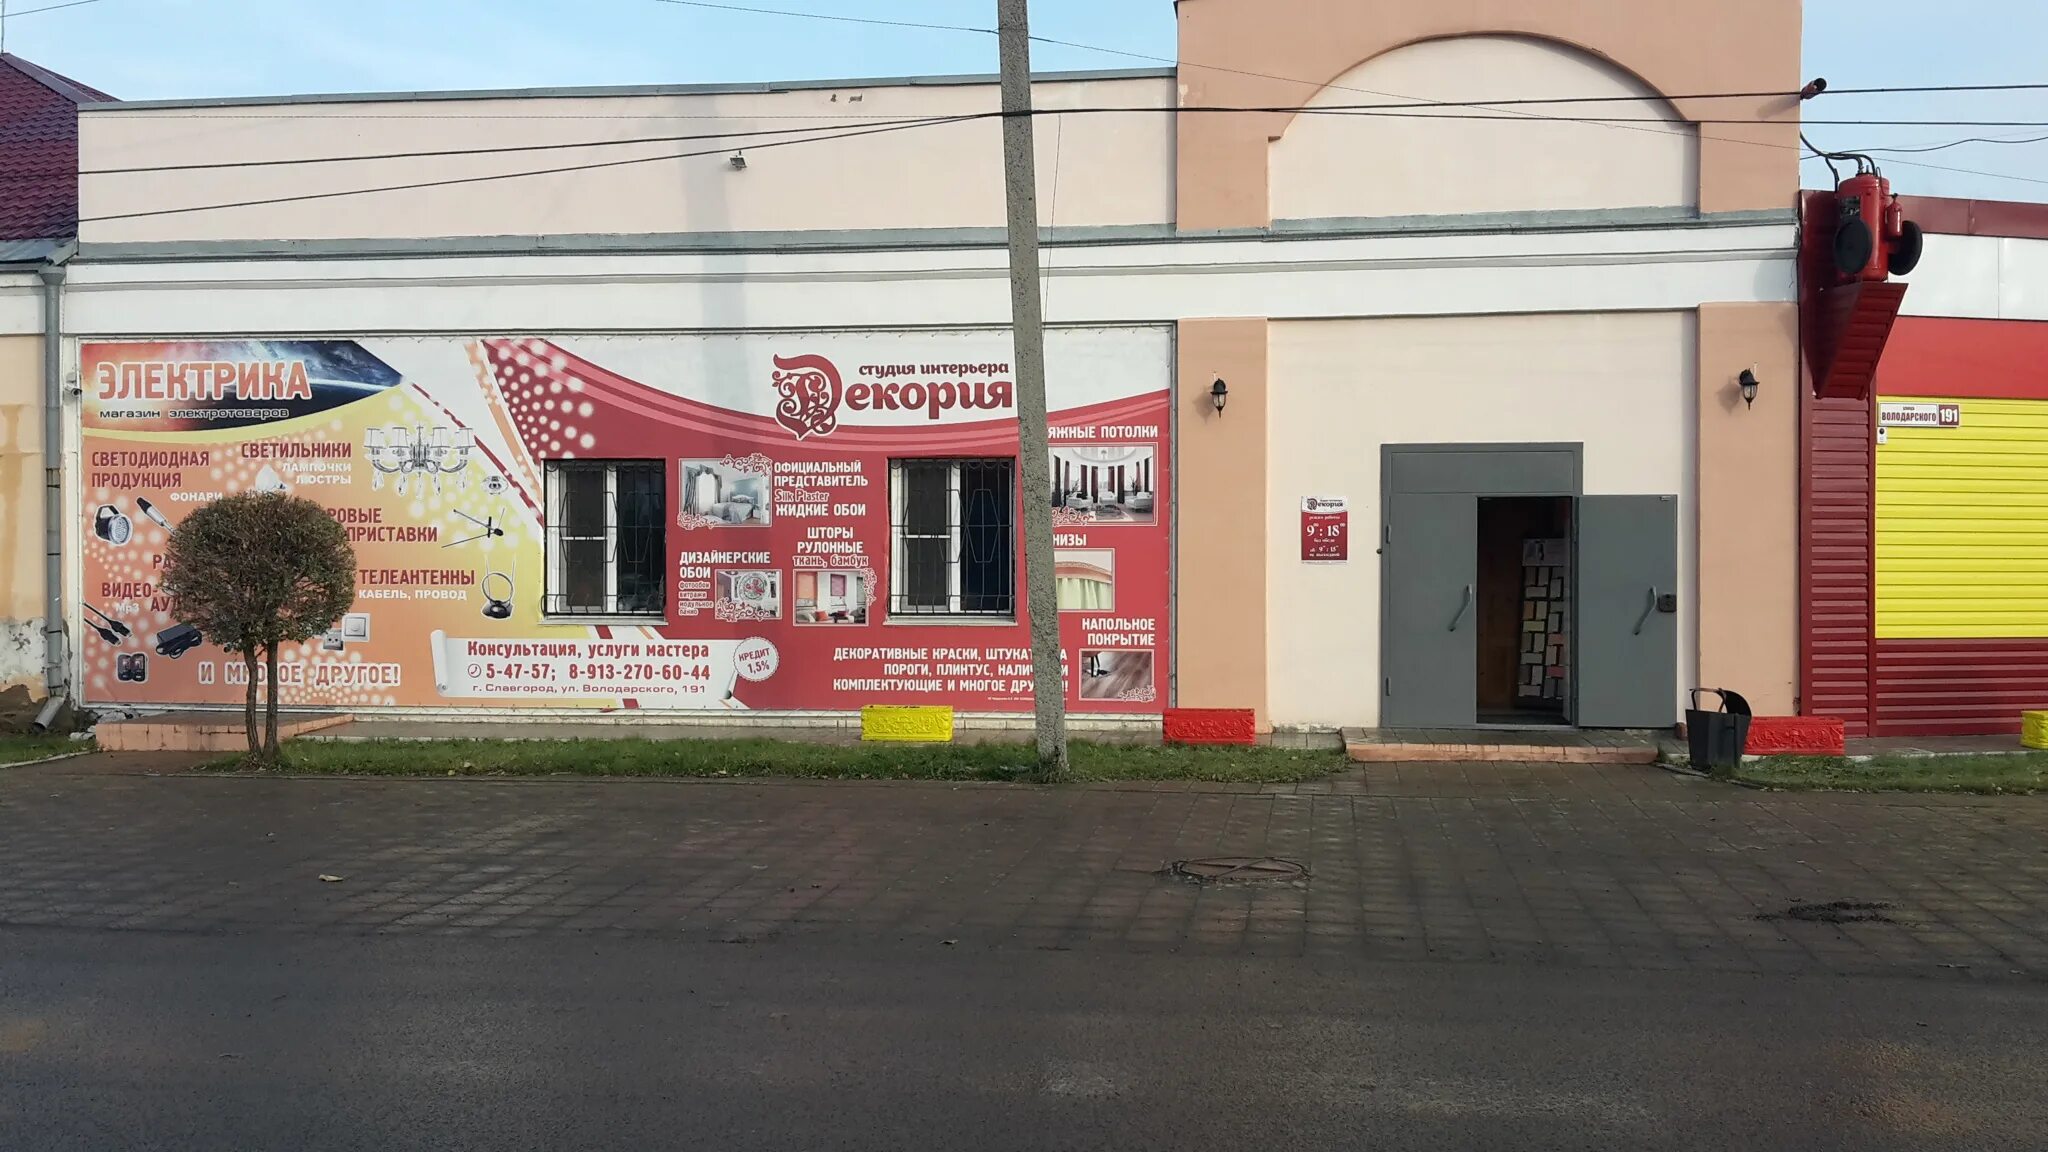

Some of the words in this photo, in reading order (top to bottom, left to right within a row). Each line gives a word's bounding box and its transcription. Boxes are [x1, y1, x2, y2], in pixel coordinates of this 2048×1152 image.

[859, 364, 915, 379] студия
[920, 363, 1009, 377] интерьера
[98, 362, 312, 399] ЭЛЕКТРИКА
[772, 354, 1012, 440] Декория
[100, 409, 160, 418] магазин
[169, 408, 289, 419] электротоваров
[1881, 412, 1937, 422] ВОЛОДАРСКОГО
[1940, 408, 1958, 422] 191
[1047, 426, 1096, 438] ЯЖНЫЕ
[1101, 426, 1158, 438] ПОТОЛКИ
[241, 443, 352, 458] СВЕТИЛЬНИКИ
[91, 451, 210, 468] СВЕТОДИОДНАЯ
[281, 462, 352, 473] ЛАМПОЧКИ
[774, 461, 862, 475] ОФИЦИАЛЬНЫЙ
[91, 473, 182, 490] ПРОДУКЦИЯ
[295, 474, 352, 485] ЛЮСТРЫ
[774, 475, 868, 488] ПРЕДСТАВИТЕЛЬ
[170, 492, 223, 502] ФОНАРИ
[774, 489, 794, 502] Silk
[795, 490, 829, 502] Plaster
[326, 508, 382, 523] РОВЫЕ
[776, 504, 829, 517] ЖИДКИЕ
[834, 504, 866, 516] ОБОИ
[807, 527, 853, 539] ШТОРЫ
[1052, 534, 1086, 546] НИЗЫ
[797, 541, 864, 554] РУЛОННЫЕ
[679, 550, 771, 565] ДИЗАЙНЕРСКИЕ
[792, 555, 828, 568] ткань,
[829, 554, 869, 567] бамбук
[359, 569, 475, 585] ТЕЛЕАНТЕННЫ
[679, 566, 711, 579] ОБОИ
[101, 583, 158, 600] ВИДЕО-
[358, 589, 412, 600] КАБЕЛЬ,
[415, 590, 467, 600] ПРОВОД
[1082, 618, 1155, 630] НАПОЛЬНОЕ
[1087, 633, 1155, 646] ПОКРЫТИЕ
[467, 641, 582, 659] Консультация,
[588, 644, 640, 660] услуги
[646, 644, 710, 660] мастера
[738, 648, 770, 662] КРЕДИТ
[833, 647, 928, 661] ДЕКОРАТИВНЫЕ
[932, 648, 981, 662] КРАСКИ,
[200, 663, 213, 682] И
[316, 665, 399, 685] ДРУГОЕ!
[486, 663, 556, 681] 5-47-57;
[569, 663, 711, 680] 8-913-270-60-44
[747, 660, 770, 674] 1,5%
[884, 664, 932, 677] ПОРОГИ,
[936, 664, 993, 677] ПЛИНТУС,
[485, 683, 557, 693] Славгород,
[561, 686, 579, 694] ул.
[583, 684, 677, 694] Володарского,
[682, 685, 705, 693] 191
[833, 678, 944, 693] КОМПЛЕКТУЮЩИЕ
[947, 679, 955, 691] И
[959, 680, 1006, 691] МНОГОЕ
